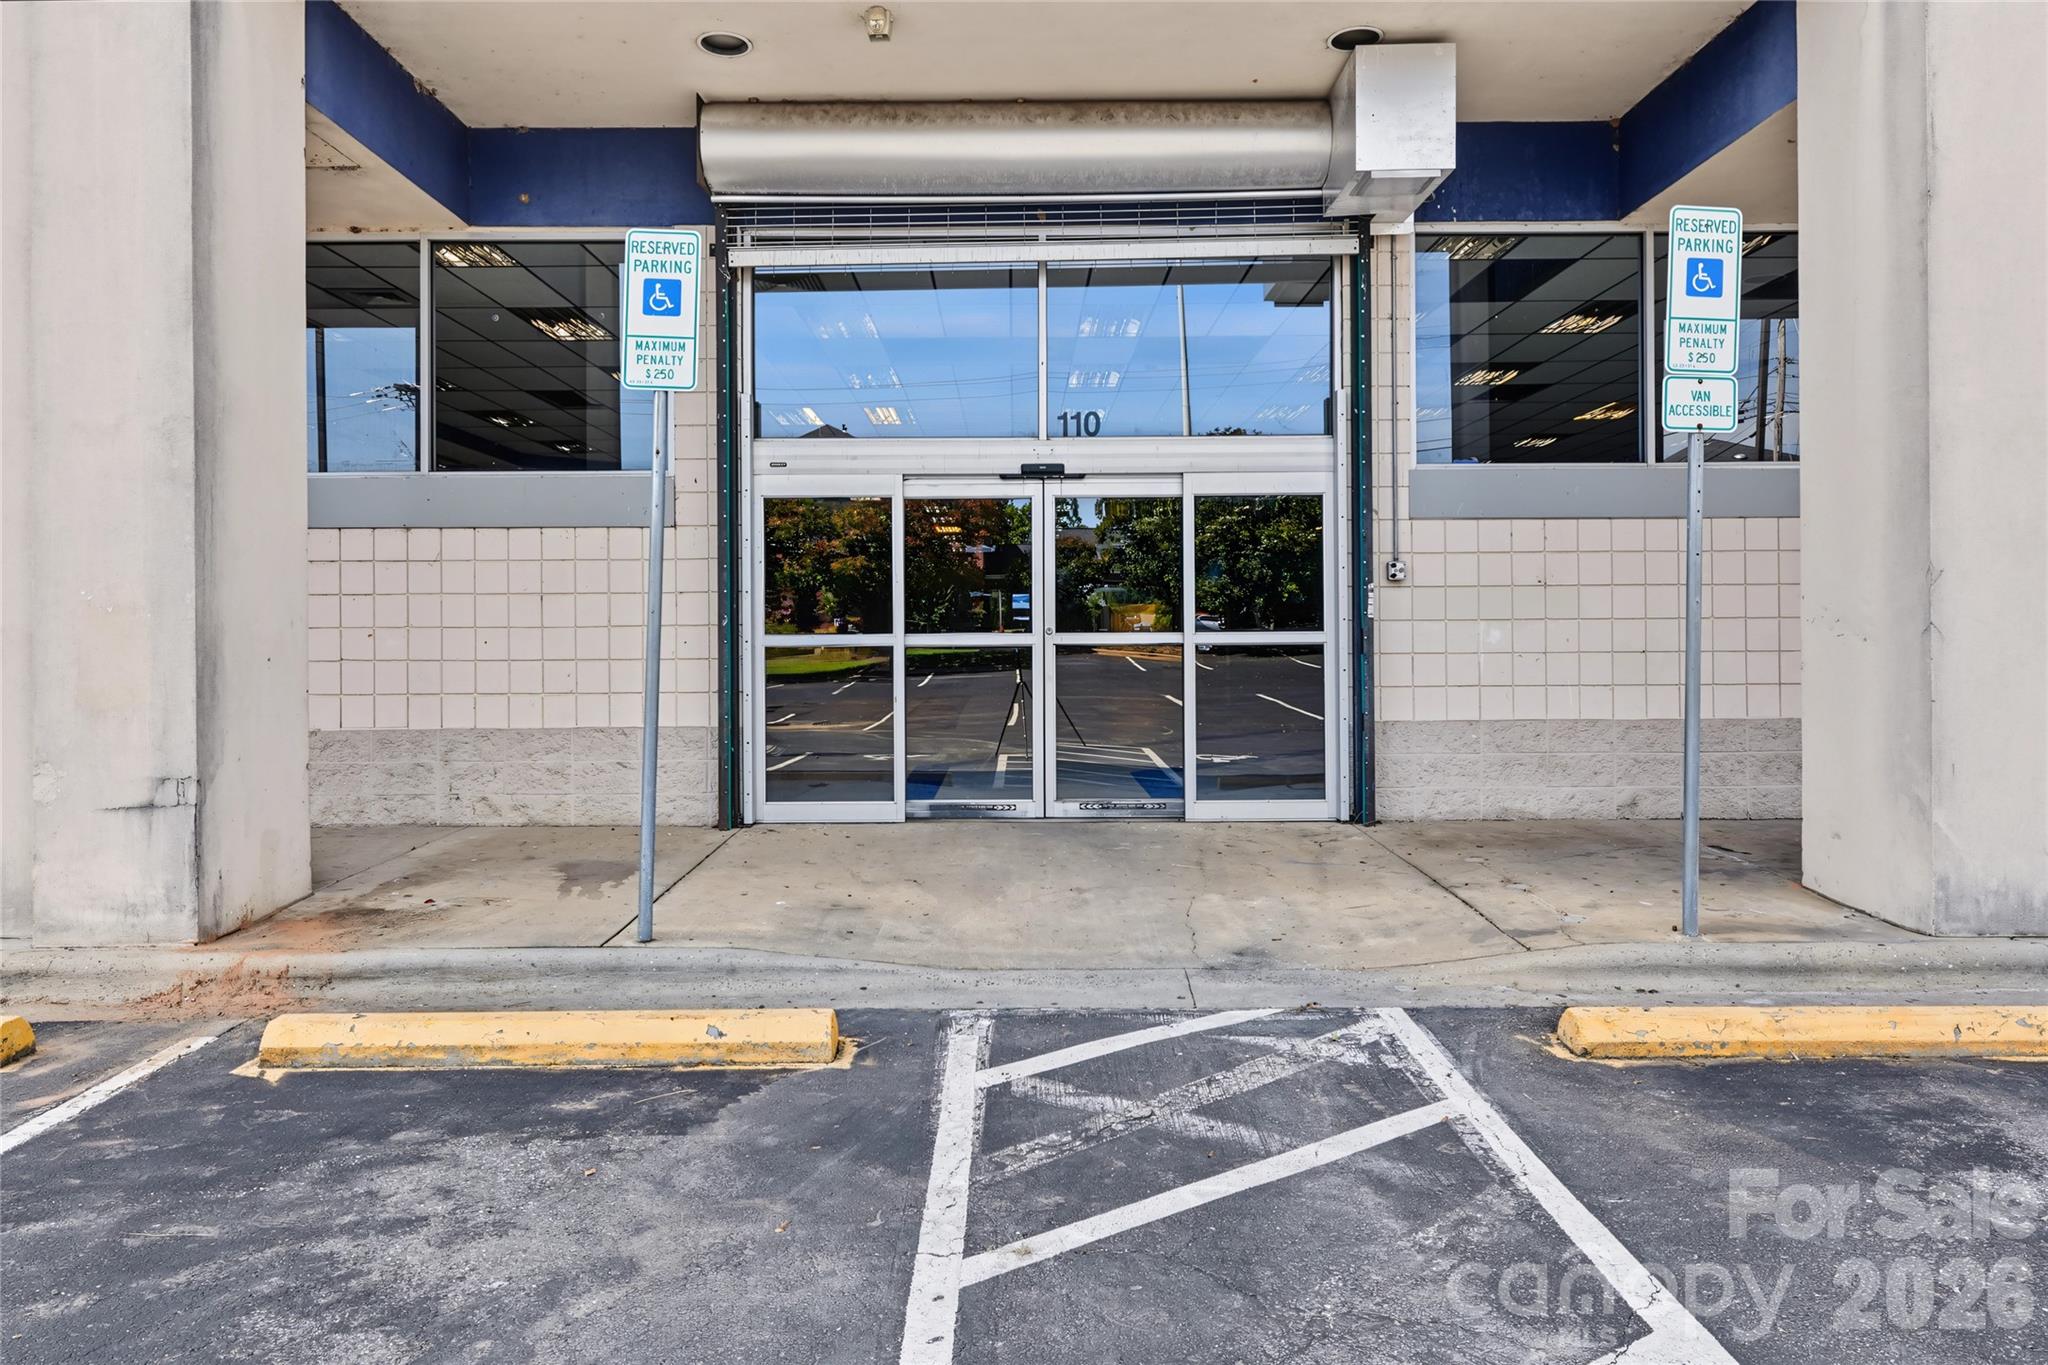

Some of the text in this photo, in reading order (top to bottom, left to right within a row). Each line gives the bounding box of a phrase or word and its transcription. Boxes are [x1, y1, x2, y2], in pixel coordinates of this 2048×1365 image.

[1675, 217, 1737, 234] RESERVED
[631, 240, 696, 256] RESERVED
[1677, 237, 1733, 254] PARKING
[633, 259, 692, 274] PARKING
[1678, 323, 1727, 335] MAXIMUM
[635, 340, 686, 352] MAXIMUM
[1679, 337, 1725, 349] PENALTY
[636, 354, 684, 366] PENALTY
[1690, 390, 1711, 402] VAN
[1668, 404, 1732, 417] ACCESSIBLE
[1057, 411, 1101, 437] 110
